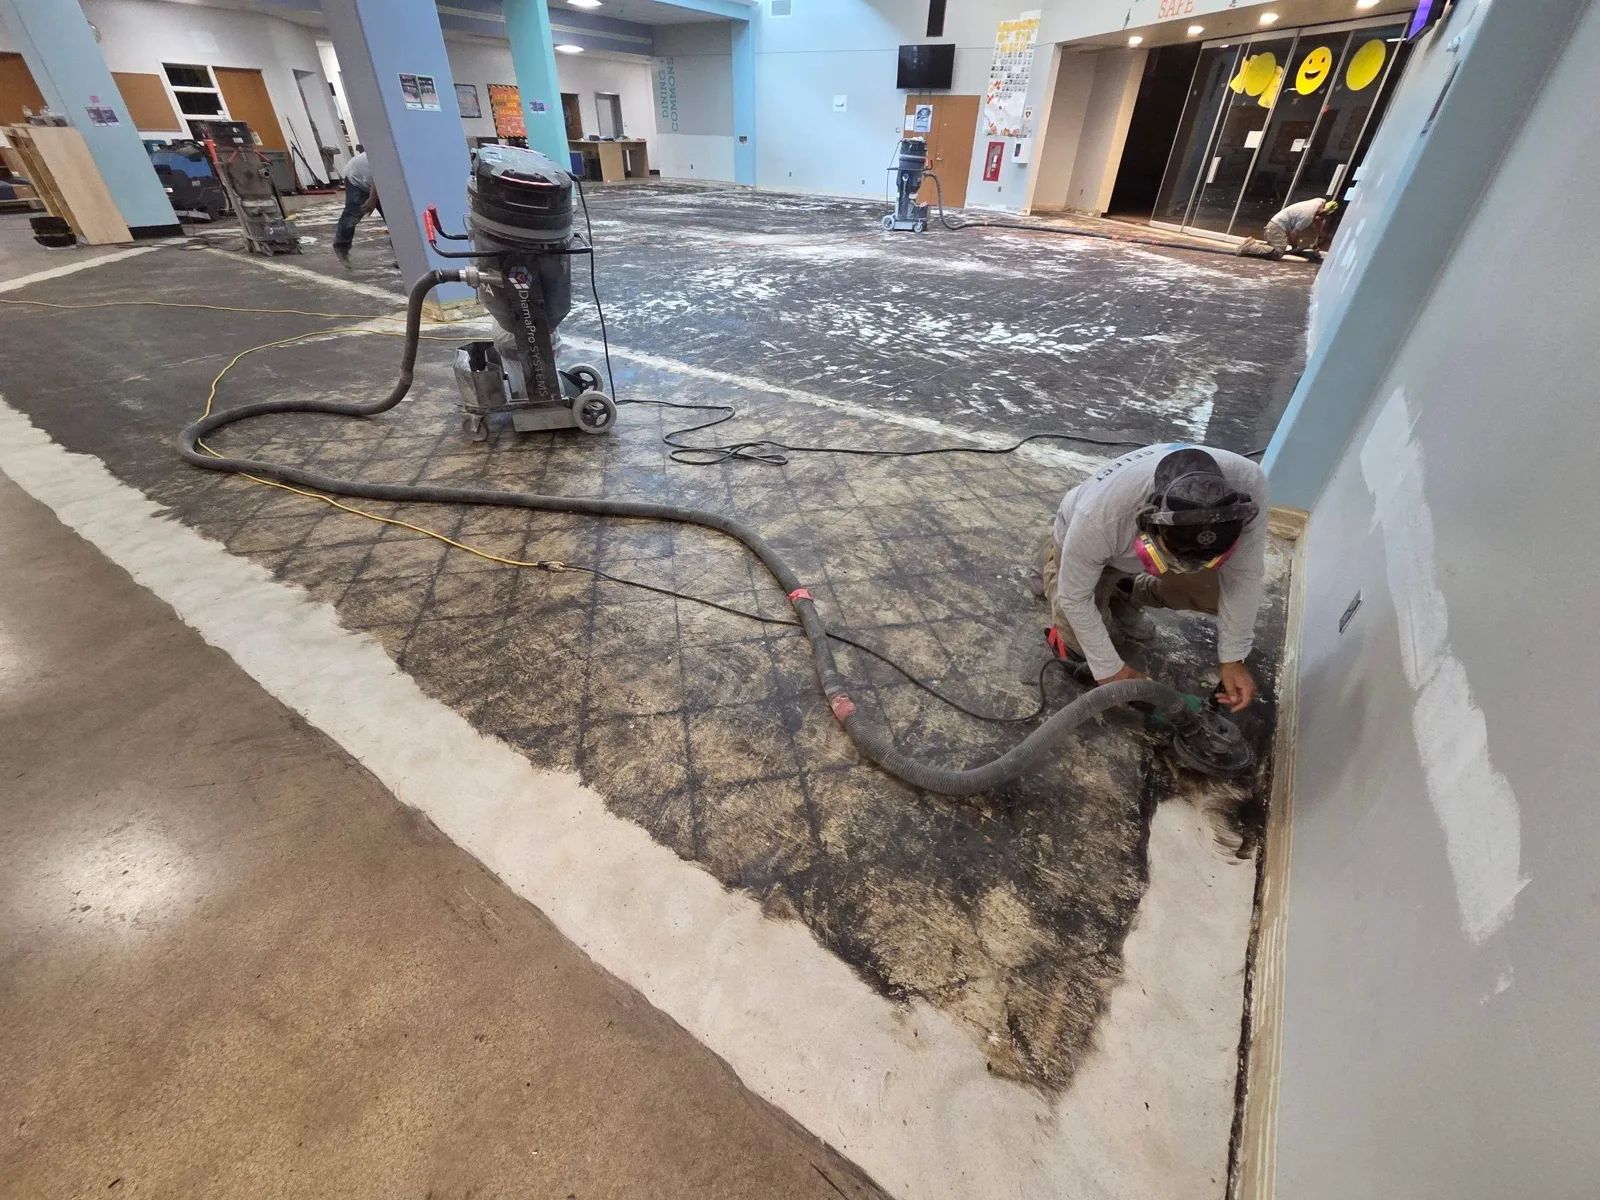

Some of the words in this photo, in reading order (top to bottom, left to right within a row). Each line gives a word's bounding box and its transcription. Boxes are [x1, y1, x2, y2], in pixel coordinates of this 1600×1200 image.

[1157, 0, 1195, 18] SAFE
[659, 69, 669, 118] DINING
[667, 56, 679, 132] COMMONS
[518, 289, 536, 344] DiamaPro
[530, 346, 549, 397] SYSTEMS
[1096, 450, 1155, 481] SELECT
